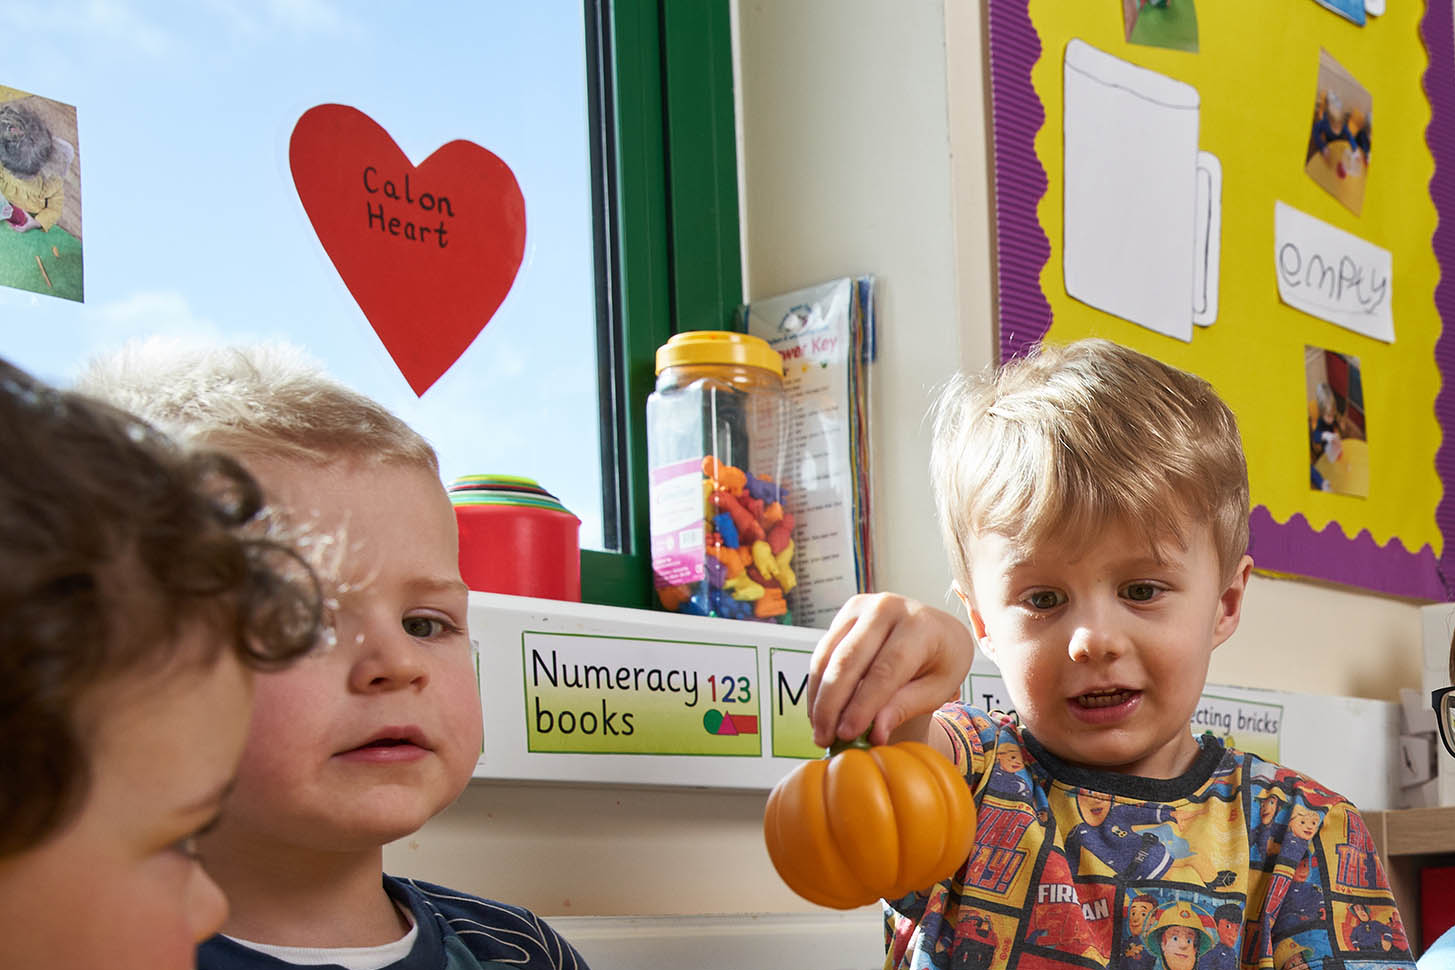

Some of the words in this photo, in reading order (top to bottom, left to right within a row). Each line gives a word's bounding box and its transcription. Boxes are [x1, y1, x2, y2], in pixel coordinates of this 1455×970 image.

[363, 166, 455, 218] Calon
[366, 201, 449, 248] Heart
[531, 649, 699, 707] Numeracy
[706, 674, 752, 705] 123
[534, 697, 634, 735] books
[1237, 708, 1278, 734] bricks
[965, 844, 1024, 893] AY!
